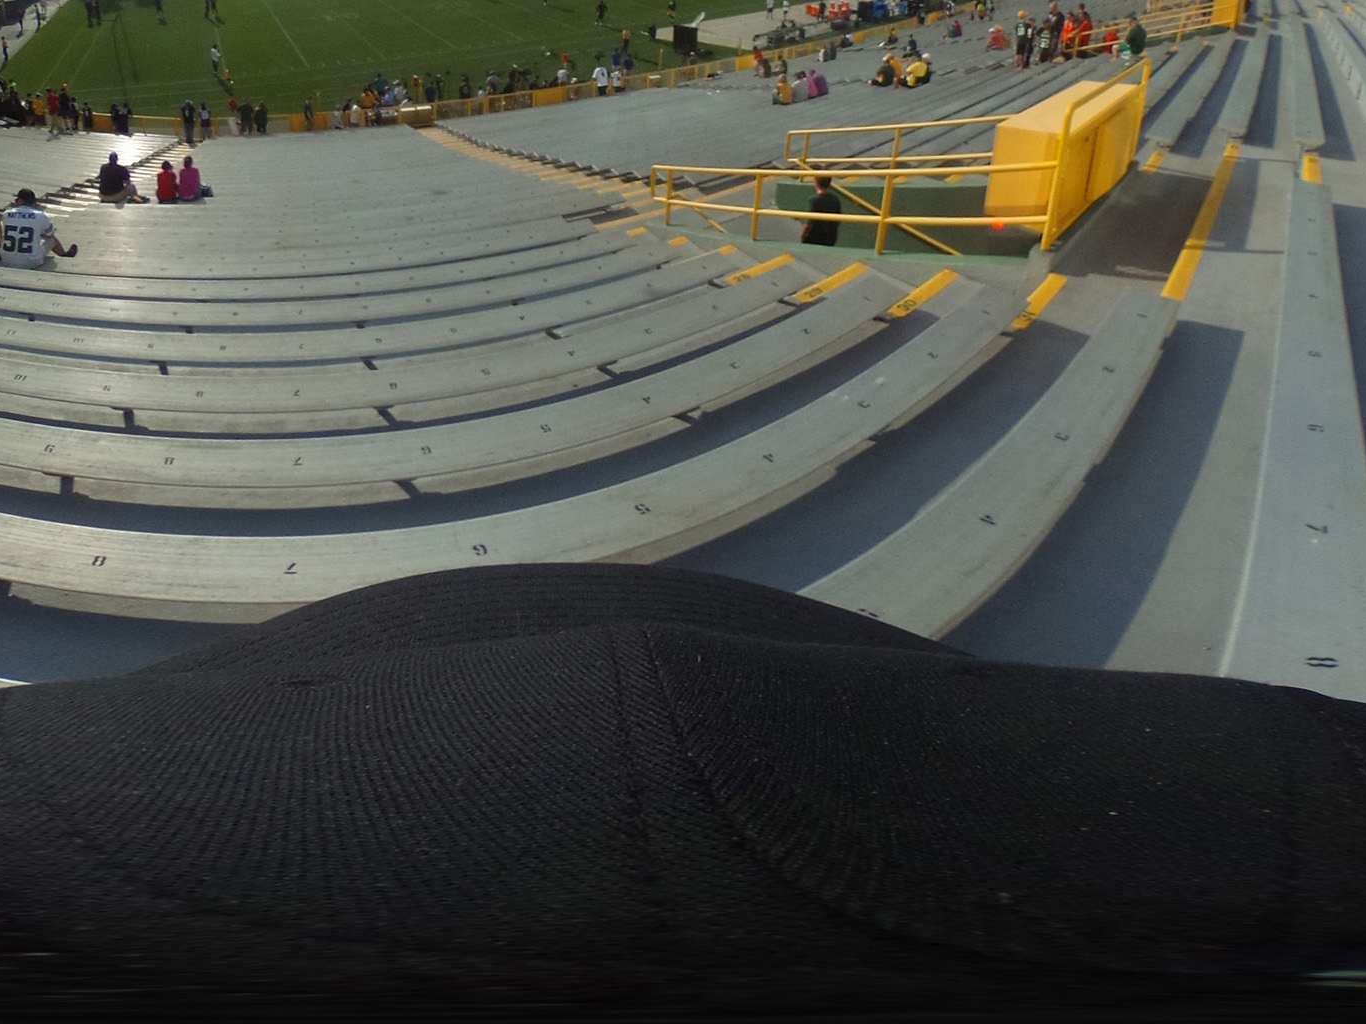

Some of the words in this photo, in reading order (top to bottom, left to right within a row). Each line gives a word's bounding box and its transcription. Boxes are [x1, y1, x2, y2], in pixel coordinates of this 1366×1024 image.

[8, 211, 35, 219] MATTHEWS
[3, 225, 34, 253] 52
[895, 299, 916, 311] 30
[1055, 433, 1069, 441] 3
[44, 444, 55, 453] 9
[293, 457, 302, 466] 7
[763, 454, 773, 462] 4
[634, 504, 651, 514] 5
[980, 515, 995, 525] 4
[1306, 524, 1328, 534] 7
[472, 544, 488, 556] 6
[91, 555, 107, 567] 8
[284, 562, 297, 575] 7
[1306, 657, 1338, 668] 8
